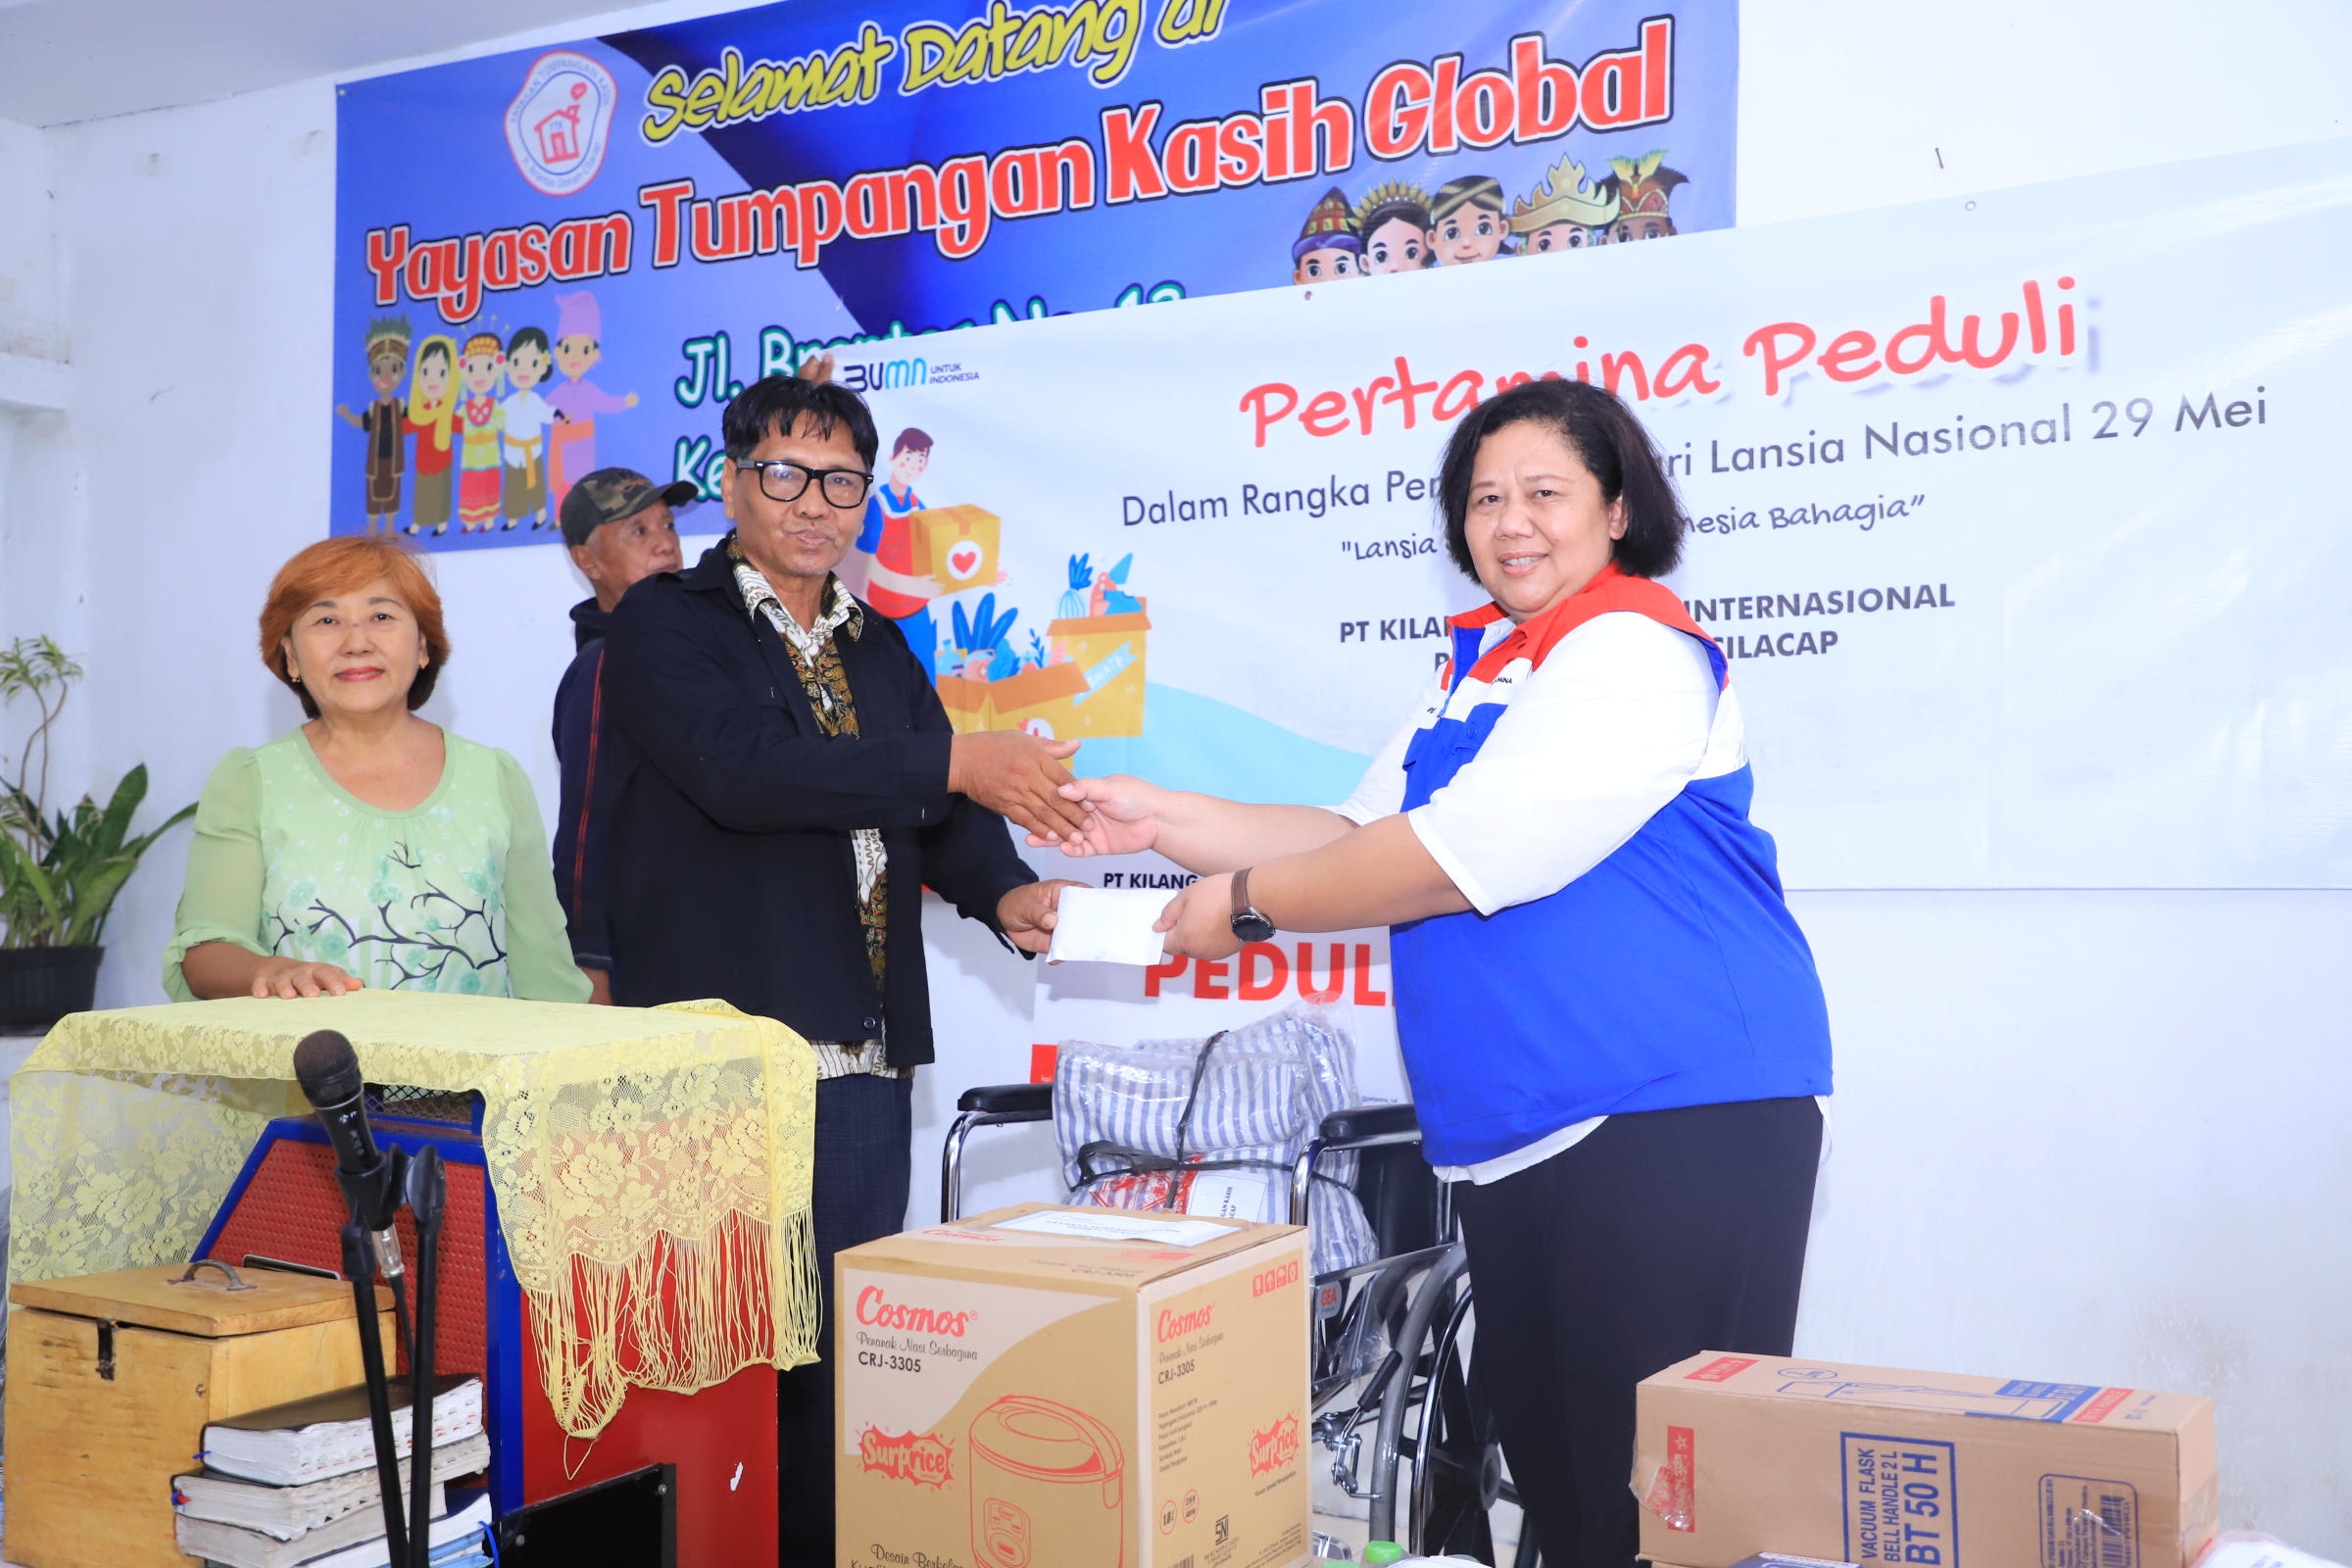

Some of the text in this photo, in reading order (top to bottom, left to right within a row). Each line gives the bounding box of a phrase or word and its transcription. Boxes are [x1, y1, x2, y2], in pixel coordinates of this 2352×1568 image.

[641, 22, 895, 145] Selamat
[899, 0, 1141, 89] Datang
[367, 15, 1675, 324] Yayasan Tumpangan Kasih Global
[1742, 275, 2076, 397] Peduli
[929, 371, 981, 384] INDONESIA
[930, 363, 962, 374] UNTUK
[1122, 493, 1229, 526] Dalam
[1243, 475, 1370, 519] Rangka
[1711, 429, 1844, 473] Lansia
[1865, 403, 2072, 461] Nasional
[2090, 397, 2154, 440] 29
[2175, 386, 2268, 434] Mei
[1341, 620, 1370, 643] PT
[1103, 873, 1199, 890] PT KILANG
[1145, 941, 1396, 1006] PEDUL
[857, 1285, 969, 1338] Cosmos
[1321, 1288, 1338, 1307] GEA
[1157, 1304, 1212, 1344] Cosmos
[856, 1331, 978, 1362] Penanak Nasi Serbaguna
[858, 1351, 922, 1373] CRJ-3305
[1157, 1358, 1196, 1385] CRJ-3305
[861, 1430, 947, 1480] Surprice
[1251, 1428, 1296, 1470] Surprice
[1857, 1447, 1878, 1558] VACUUM FLASK
[1881, 1450, 1901, 1562] BELL HANDLE 2 L
[1901, 1452, 1940, 1565] BT 50 H
[870, 1544, 909, 1565] Desain
